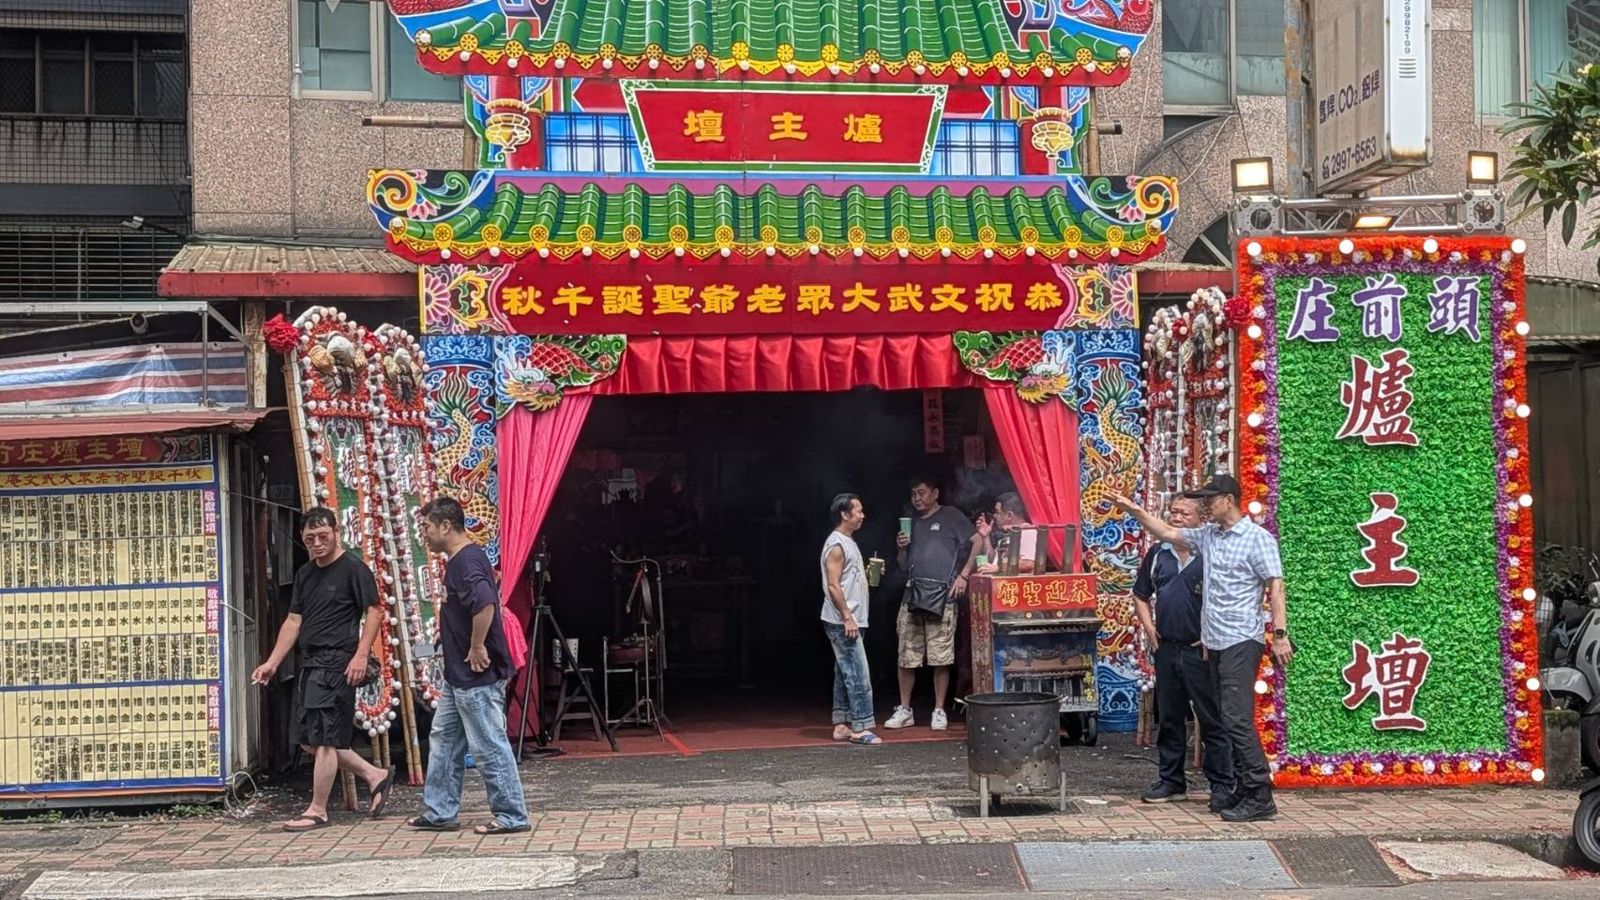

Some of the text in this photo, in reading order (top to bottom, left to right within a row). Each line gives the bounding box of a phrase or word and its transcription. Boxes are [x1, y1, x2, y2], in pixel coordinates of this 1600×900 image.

[682, 109, 885, 143] 爐主壇
[1331, 136, 1377, 175] 2997-6563
[501, 281, 1064, 317] 恭祝文武大眾老爺聖誕千秋
[1286, 274, 1481, 343] 頭前庄
[0, 468, 202, 488] 庵文武大眾老爺聖誕千秋
[1336, 349, 1430, 732] 爐主壇
[997, 579, 1095, 607] 恭迎聖駕
